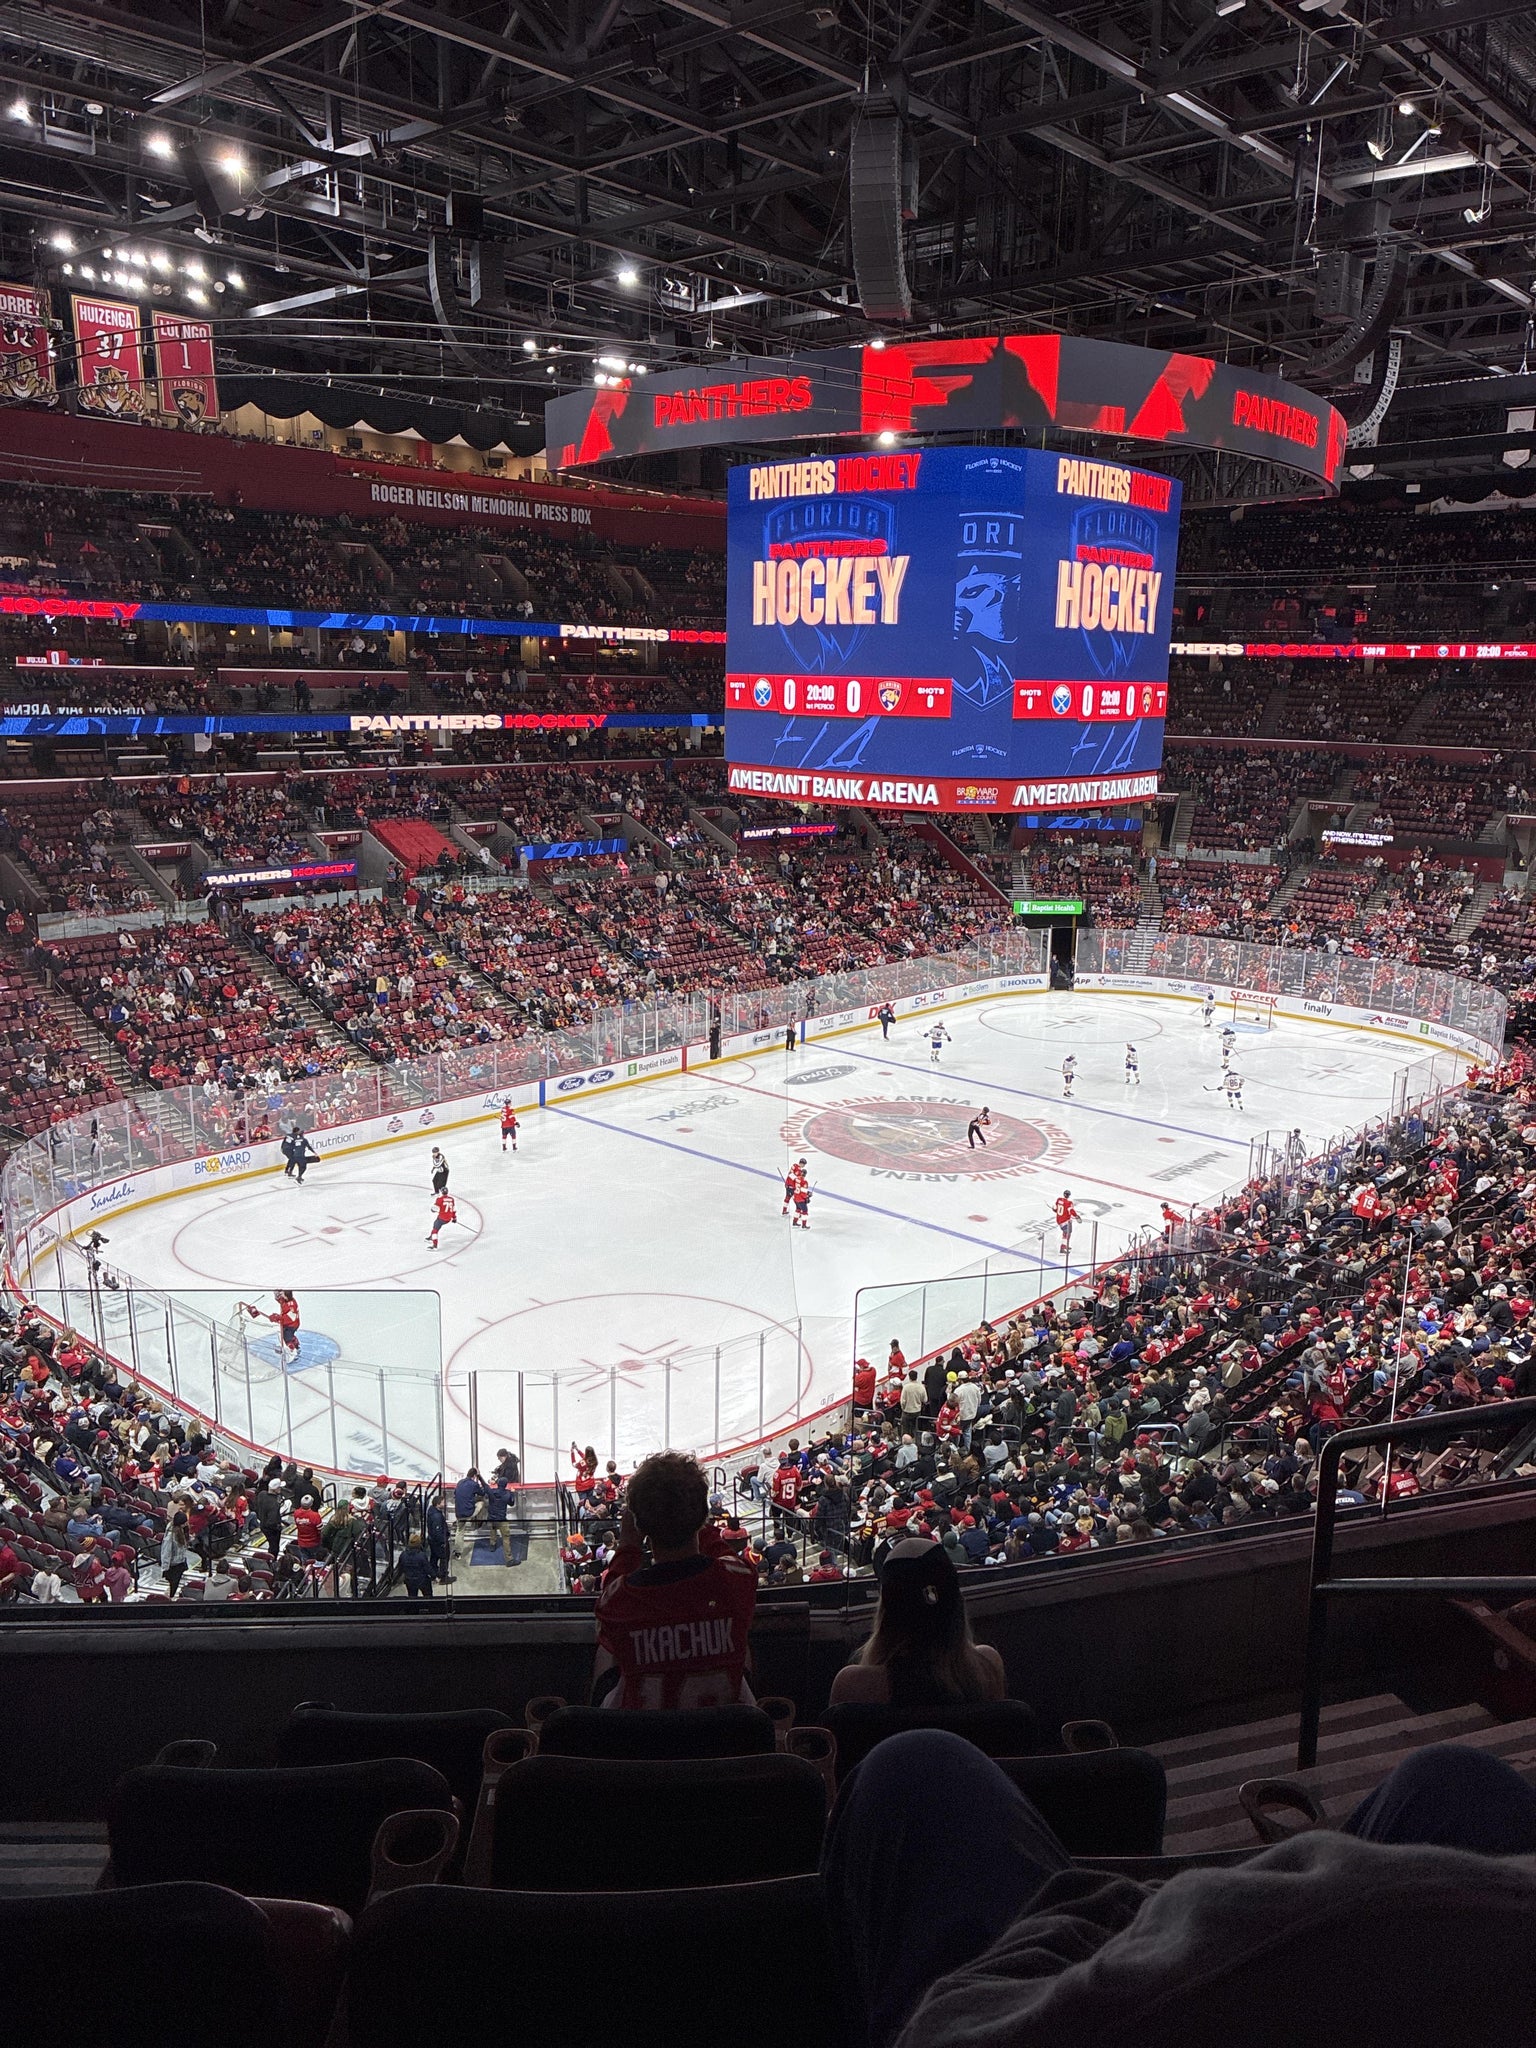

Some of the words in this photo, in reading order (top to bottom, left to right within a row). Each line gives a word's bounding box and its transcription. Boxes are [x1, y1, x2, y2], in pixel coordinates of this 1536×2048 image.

[79, 304, 134, 329] HUIZENGA
[96, 330, 123, 360] 37
[180, 342, 191, 369] 1
[654, 376, 813, 428] PANTHERS
[1233, 390, 1319, 448] PANTHERS
[965, 458, 988, 472] FLORIDA
[750, 459, 836, 501] PANTHERS
[837, 453, 921, 493] HOCKEY
[1057, 457, 1131, 504] PANTHERS
[1130, 471, 1172, 512] HOCKEY
[371, 483, 414, 506] ROGER
[416, 488, 470, 512] NEILSON
[471, 495, 532, 519] MEMORIAL
[534, 503, 568, 524] PRESS
[570, 508, 592, 525] BOX
[776, 503, 880, 540] FLORIDA
[1084, 510, 1151, 547] FLORIDA
[962, 521, 1015, 545] ORI
[768, 538, 888, 559] PANTHERS
[1075, 544, 1154, 569] PANTHERS
[753, 555, 910, 625] HOCKEY
[1055, 559, 1163, 634] HOCKEY
[560, 624, 669, 642] PANTHERS
[1246, 643, 1356, 657] HOCKEY
[784, 679, 796, 710] 0
[806, 685, 835, 702] 20:00
[846, 680, 861, 713] 0
[917, 687, 945, 695] SHOTS
[1020, 689, 1041, 697] SHOTS
[1101, 690, 1120, 707] 20:00
[815, 703, 835, 711] PERIOD
[1082, 685, 1094, 717] 0
[1126, 685, 1134, 717] 0
[350, 715, 502, 731] PANTHERS
[504, 714, 607, 729] HOCKEY
[952, 744, 974, 757] FLORIDA
[985, 744, 1007, 757] HOCKEY
[729, 768, 812, 797] AMERANT
[812, 776, 865, 801] BANK
[867, 781, 940, 806] ARENA
[1012, 781, 1101, 807] AMERANT
[1101, 778, 1132, 800] BANK
[1132, 775, 1158, 797] ARENA
[206, 869, 292, 886] PANTHERS
[293, 863, 355, 877] HOCKEY
[1031, 904, 1054, 913] Baptist
[1007, 977, 1043, 986] HONDA
[1303, 1001, 1332, 1017] finally
[1385, 1016, 1409, 1026] ACTION
[1430, 1026, 1449, 1040] Baptist
[638, 1060, 659, 1072] Baptist
[659, 1055, 679, 1068] Health
[560, 1077, 583, 1091] Ford
[591, 1071, 613, 1084] Ford
[1229, 1078, 1238, 1088] 86
[779, 1108, 820, 1153] AMERANT
[825, 1096, 889, 1108] BANK
[894, 1094, 972, 1106] ARENA
[315, 1132, 355, 1150] nutrition
[1022, 1117, 1073, 1165] AMERANT
[221, 1162, 251, 1174] COUNTY
[870, 1167, 960, 1182] ARENA
[966, 1165, 1041, 1182] BANK
[90, 1182, 135, 1211] Sandals
[1362, 1196, 1375, 1210] 19
[782, 1483, 795, 1500] 19
[865, 1519, 873, 1528] 6
[72, 1571, 94, 1589] 24
[629, 1617, 735, 1666] TKACHUK
